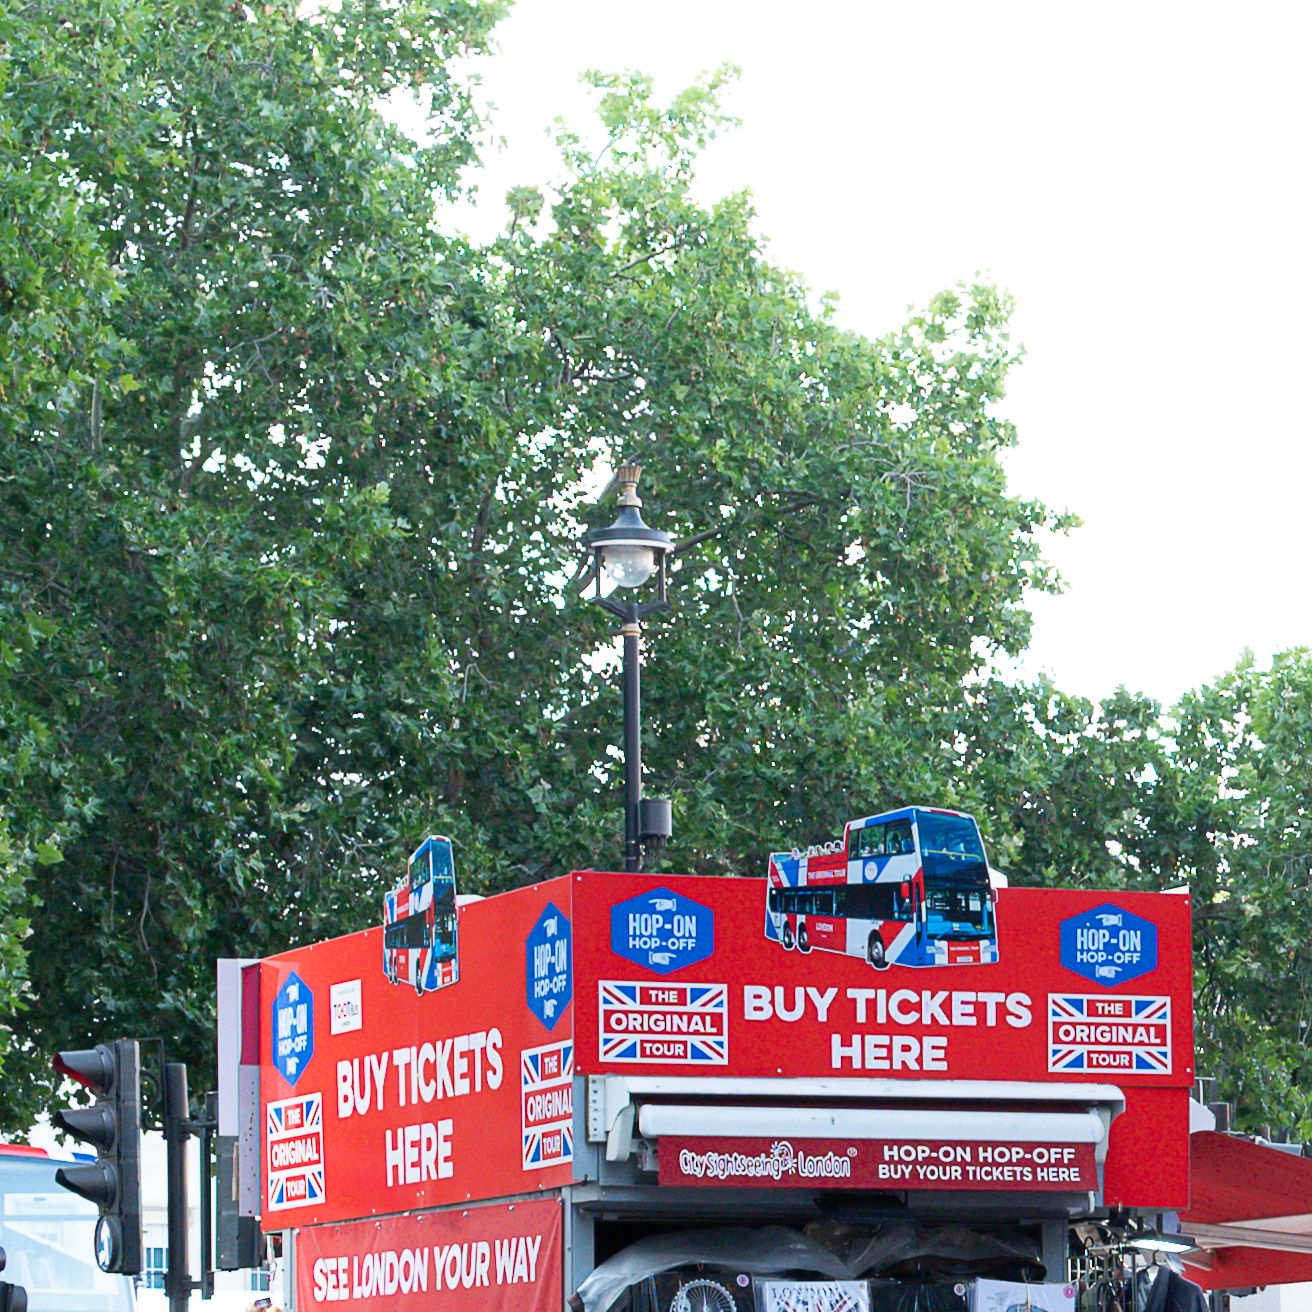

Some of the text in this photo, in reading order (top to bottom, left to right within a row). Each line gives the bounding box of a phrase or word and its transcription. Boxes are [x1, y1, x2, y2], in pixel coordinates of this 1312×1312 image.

[628, 913, 696, 937] HOP-ON
[628, 938, 696, 951] HOP-OFF
[1076, 929, 1141, 951] HOP-ON
[534, 938, 567, 977] HOP-ON
[1076, 951, 1141, 964] HOP-OFF
[534, 972, 567, 997] HOP-OFF
[648, 989, 679, 1004] THE
[743, 984, 1033, 1028] BUY TICKETS
[1096, 1002, 1123, 1015] THE
[277, 1003, 308, 1039] HOP-ON
[609, 1013, 717, 1033] ORIGINAL
[1058, 1024, 1161, 1044] ORIGINAL
[278, 1037, 307, 1057] HOP-OFF
[643, 1042, 685, 1057] TOUR
[830, 1034, 948, 1071] HERE
[543, 1055, 559, 1075] THE
[1089, 1053, 1129, 1067] TOUR
[336, 1027, 503, 1118] BUY TICKETS
[526, 1087, 573, 1121] ORIGINAL
[286, 1107, 302, 1126] THE
[271, 1137, 319, 1167] ORIGINAL
[385, 1118, 454, 1187] HERE
[542, 1133, 561, 1153] TOUR
[797, 1151, 850, 1178] London
[883, 1145, 1076, 1165] HOP-ON HOP-OFF
[878, 1165, 1080, 1182] BUY YOUR TICKETS HERE
[285, 1179, 306, 1198] TOUR
[313, 1235, 542, 1302] SEE LONDON YOUR WAY
